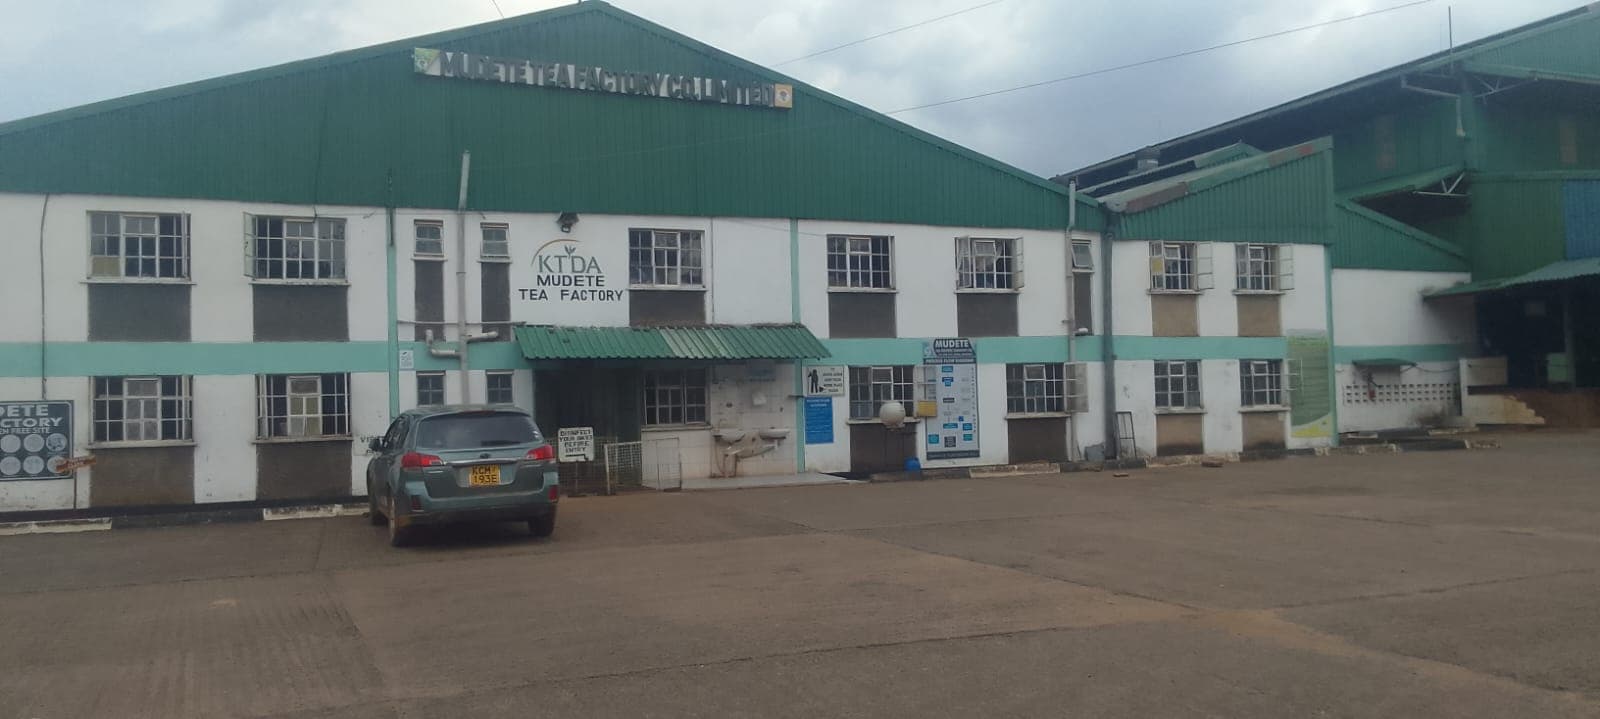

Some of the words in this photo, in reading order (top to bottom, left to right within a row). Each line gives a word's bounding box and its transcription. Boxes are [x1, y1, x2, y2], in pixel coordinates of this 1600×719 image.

[440, 51, 527, 83] MUDETE
[527, 60, 571, 88] TEA
[573, 65, 668, 97] FACTORY
[701, 77, 774, 107] LIMITED
[538, 255, 602, 274] KTDA
[537, 275, 605, 287] MUDETE
[518, 289, 548, 301] TEA
[560, 289, 624, 301] FACTORY
[935, 340, 969, 348] MUDETE
[472, 466, 491, 475] KCM
[474, 474, 497, 483] 193E
